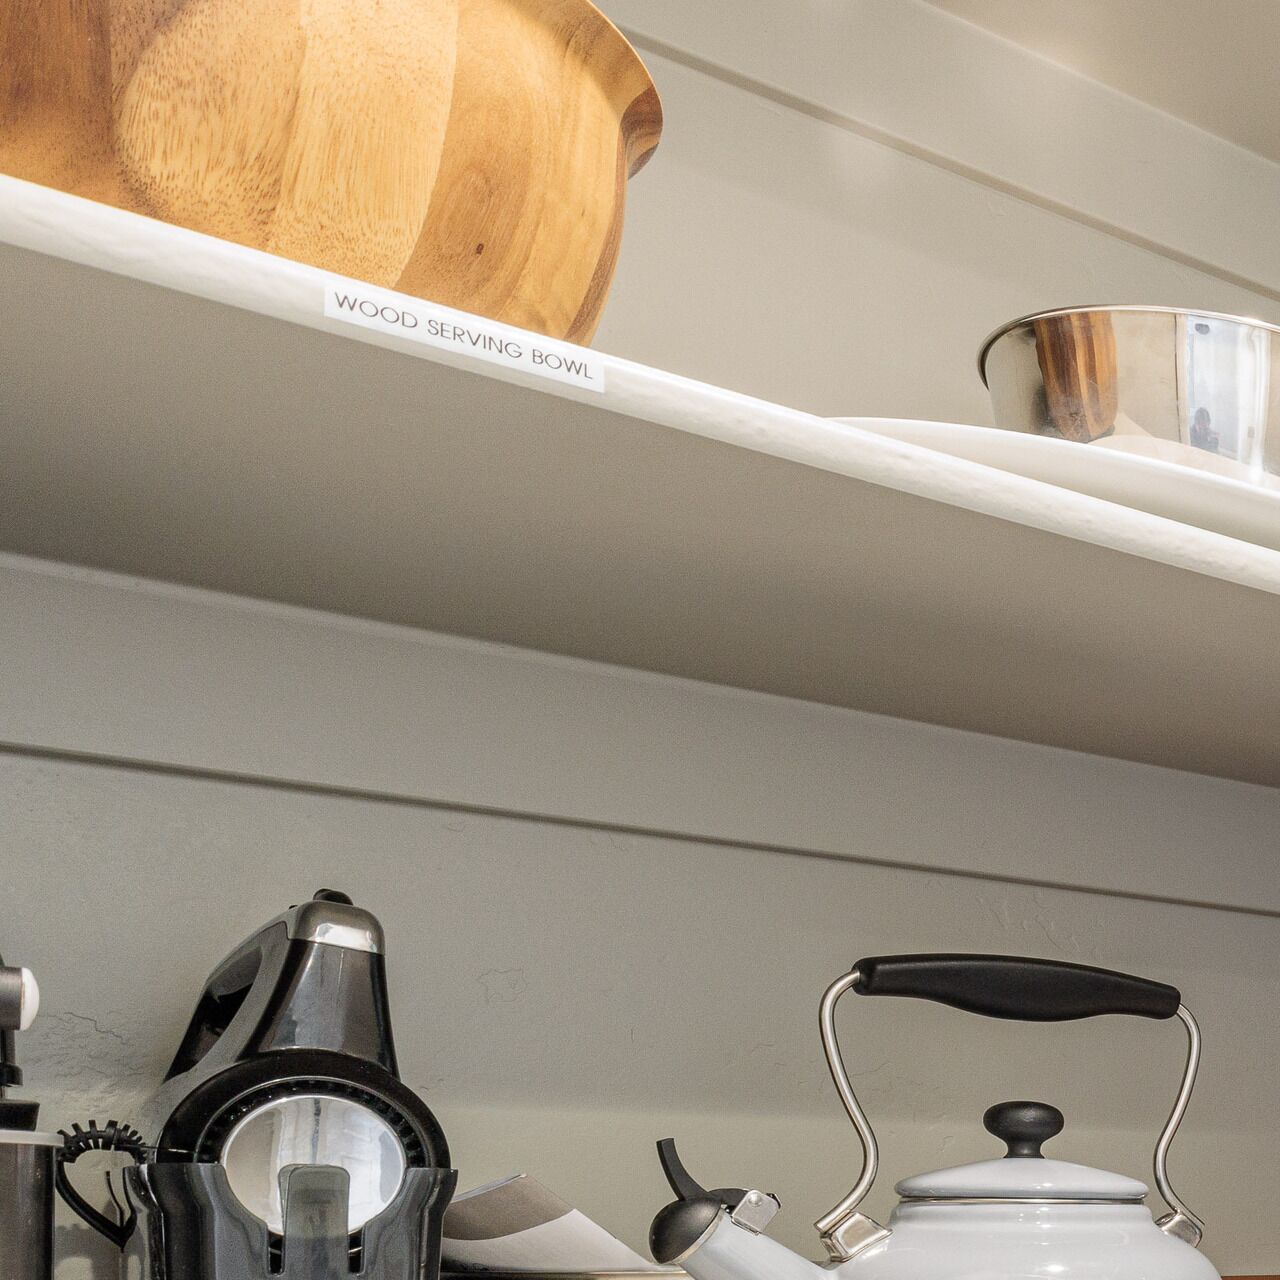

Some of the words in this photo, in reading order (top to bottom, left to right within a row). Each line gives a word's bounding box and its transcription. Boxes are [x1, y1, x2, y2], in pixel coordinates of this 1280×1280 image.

[335, 292, 418, 328] WOOD
[428, 320, 522, 358] SERVING
[532, 349, 593, 379] BOWL
